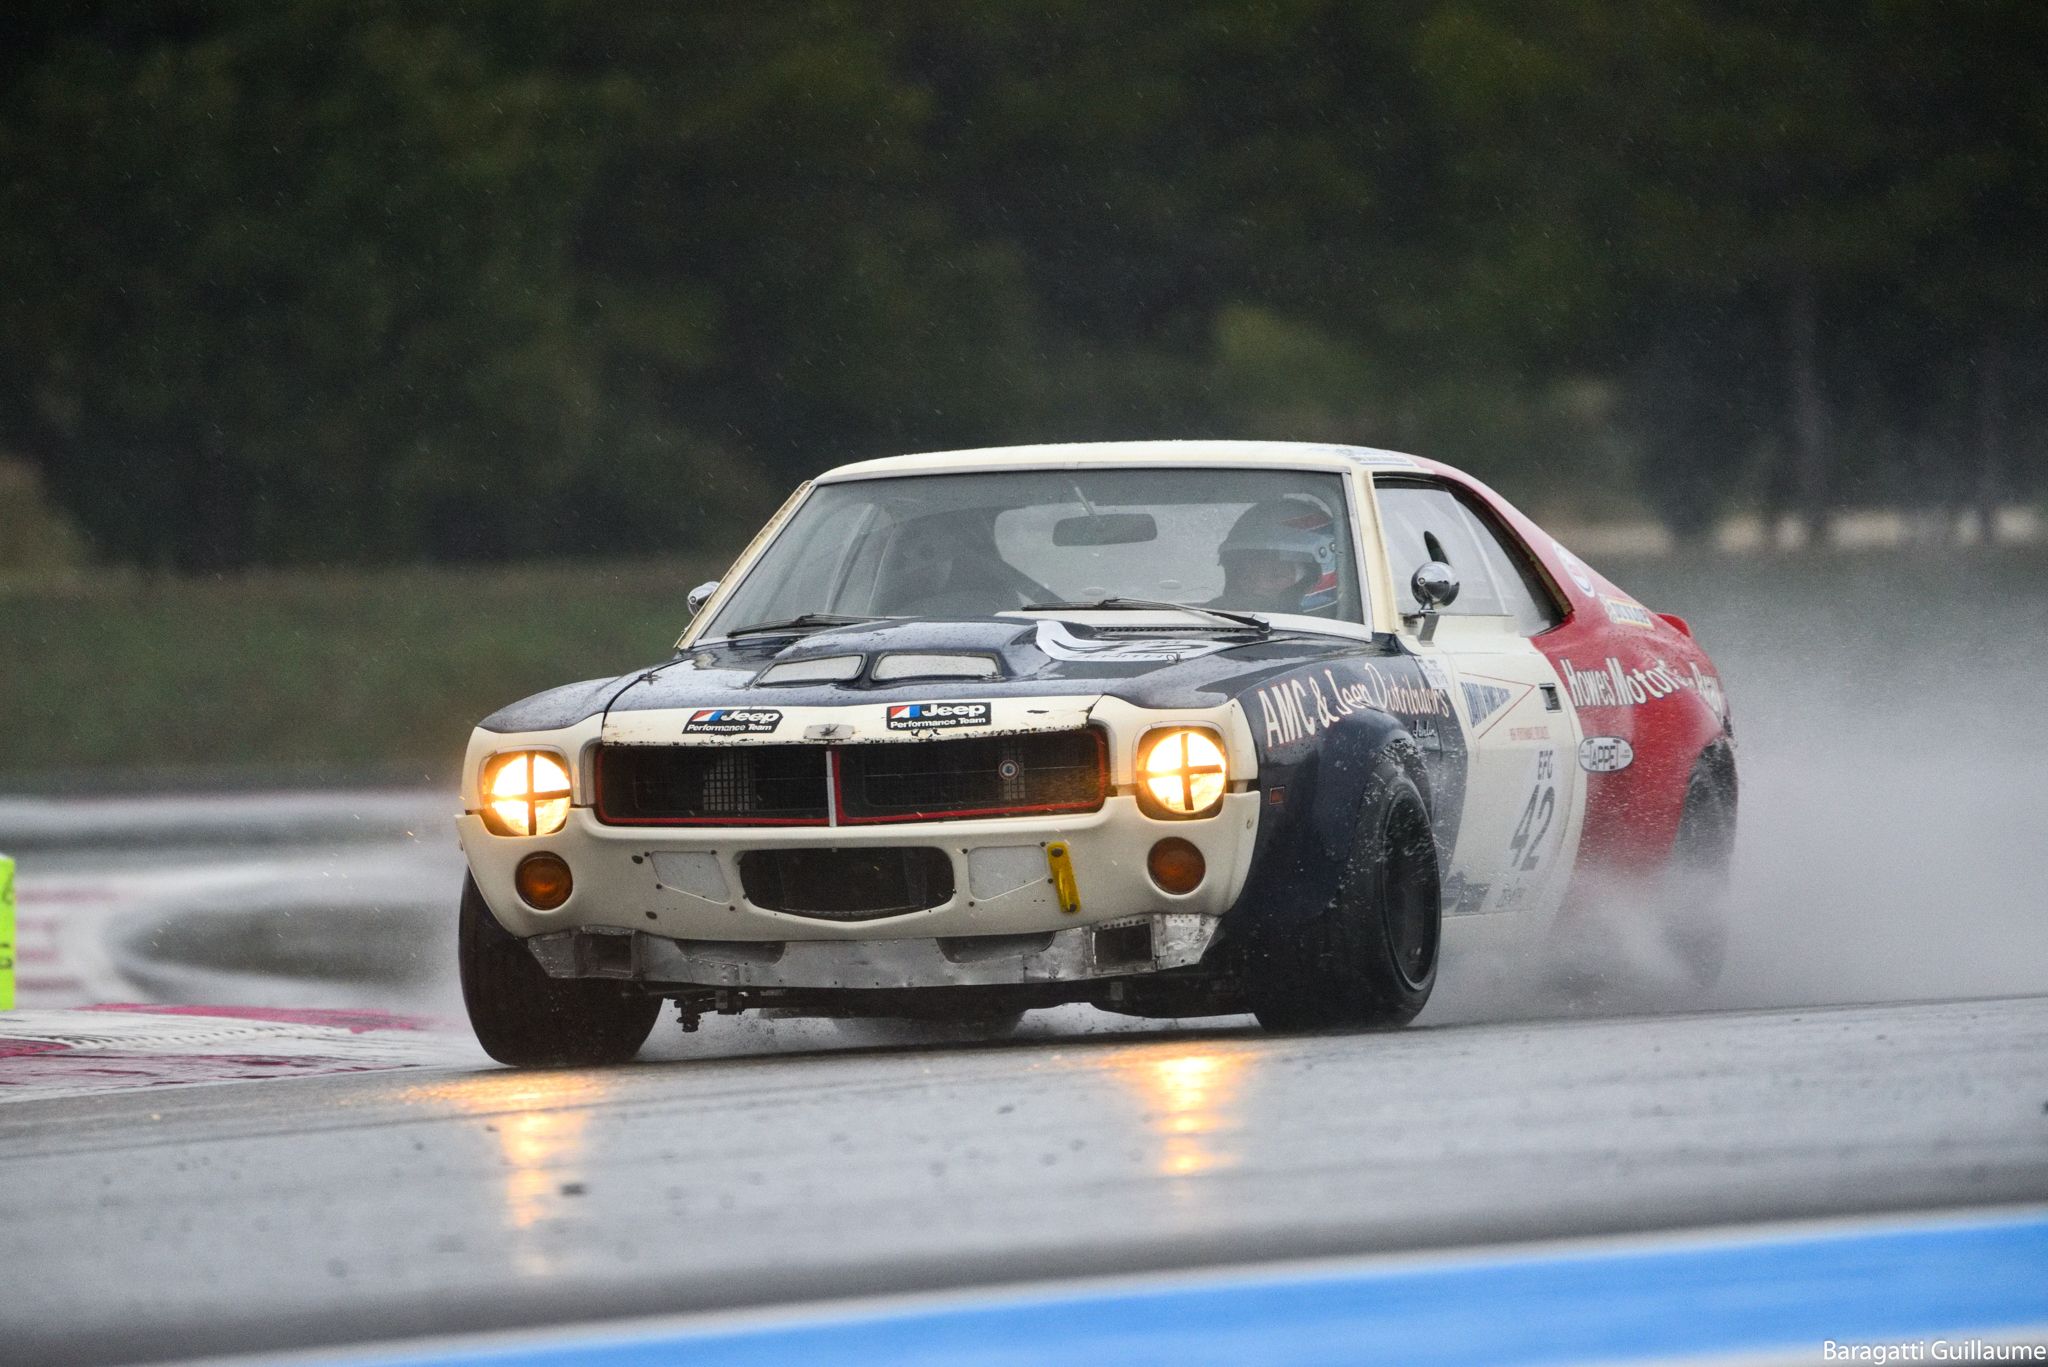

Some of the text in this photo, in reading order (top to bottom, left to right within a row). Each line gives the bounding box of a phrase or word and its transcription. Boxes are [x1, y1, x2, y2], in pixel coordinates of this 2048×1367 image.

[1559, 658, 1616, 706] Howes
[921, 703, 986, 718] Jeep
[1257, 679, 1315, 748] AMC
[1309, 677, 1339, 728] &
[1365, 662, 1450, 718] Distributors
[721, 710, 780, 723] Jeep
[890, 717, 986, 729] Performance Team
[687, 723, 773, 732] Performance Team
[1509, 784, 1555, 872] 42
